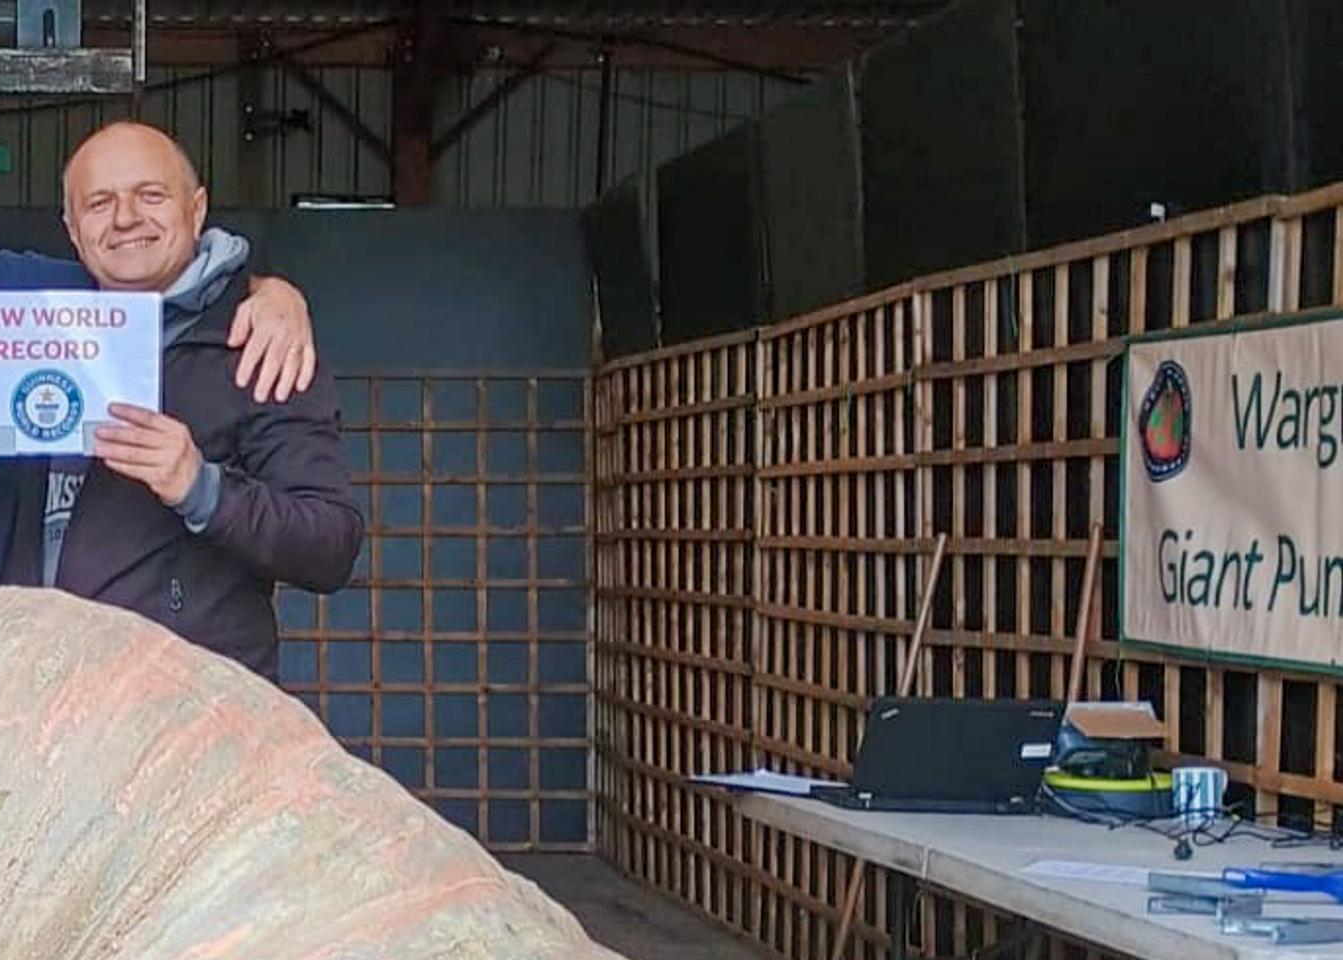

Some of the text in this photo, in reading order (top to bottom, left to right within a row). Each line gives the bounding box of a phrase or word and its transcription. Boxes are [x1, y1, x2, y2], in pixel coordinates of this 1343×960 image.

[32, 308, 127, 327] WORLD
[1231, 370, 1343, 468] Warg
[1158, 529, 1263, 611] Giant
